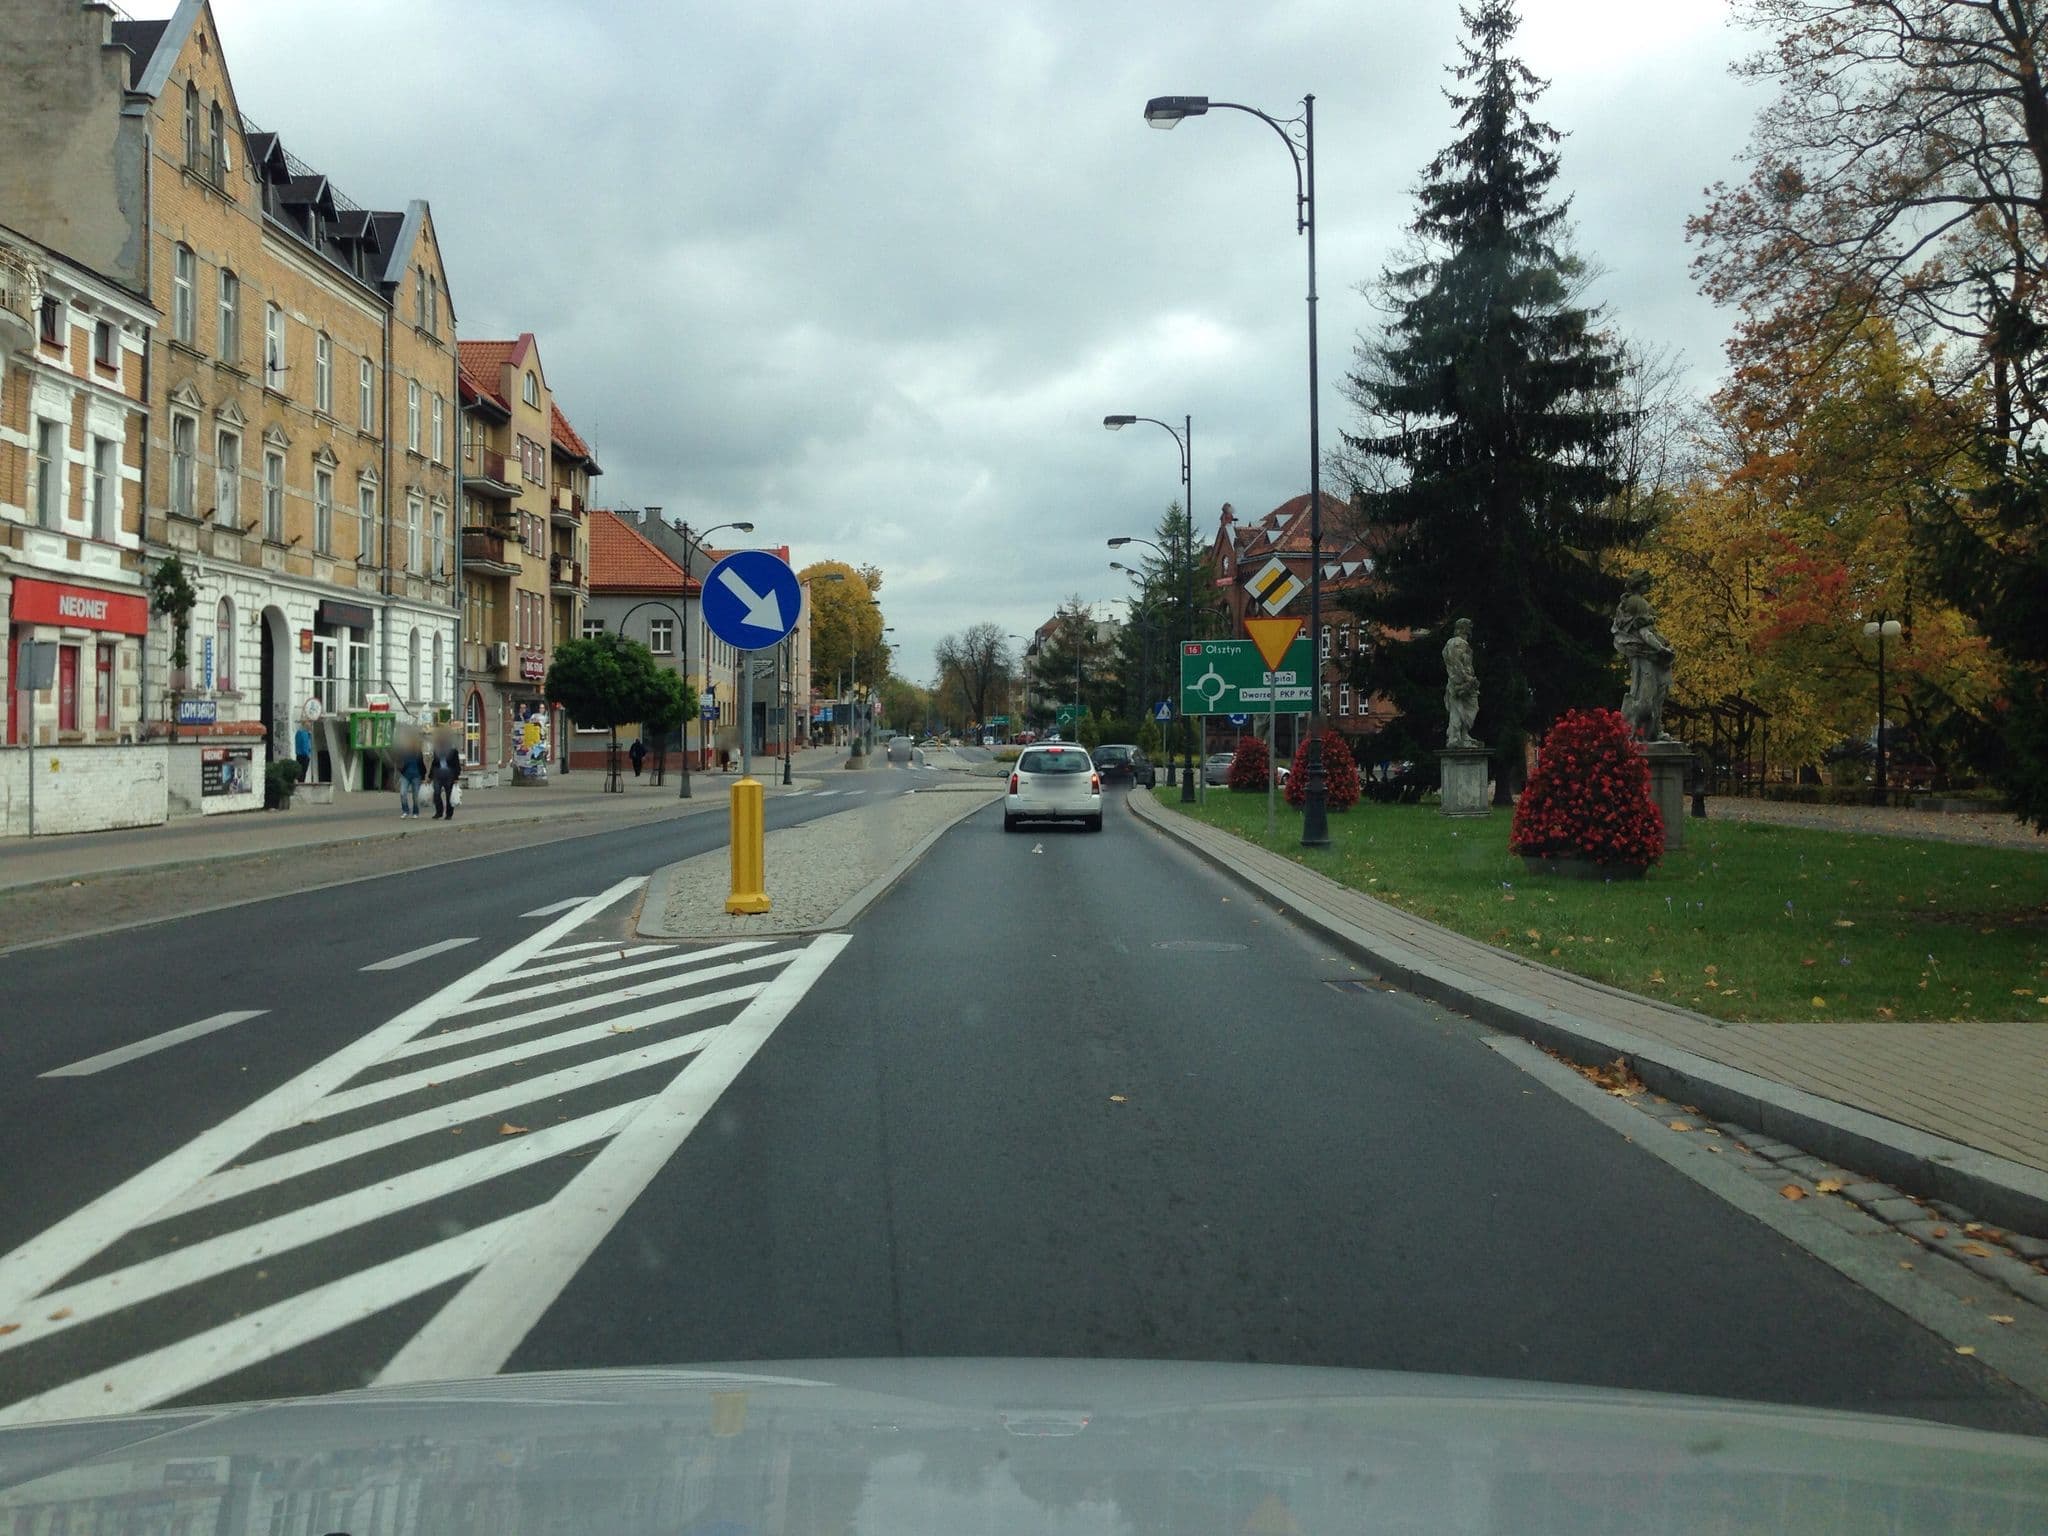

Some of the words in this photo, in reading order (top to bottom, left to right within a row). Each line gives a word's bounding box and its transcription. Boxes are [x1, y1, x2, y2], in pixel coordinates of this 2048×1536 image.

[59, 595, 108, 620] NEONET
[1188, 646, 1198, 655] 16
[1205, 644, 1241, 656] Olsztyn
[1264, 673, 1294, 684] Spital
[1242, 690, 1276, 699] Dworze
